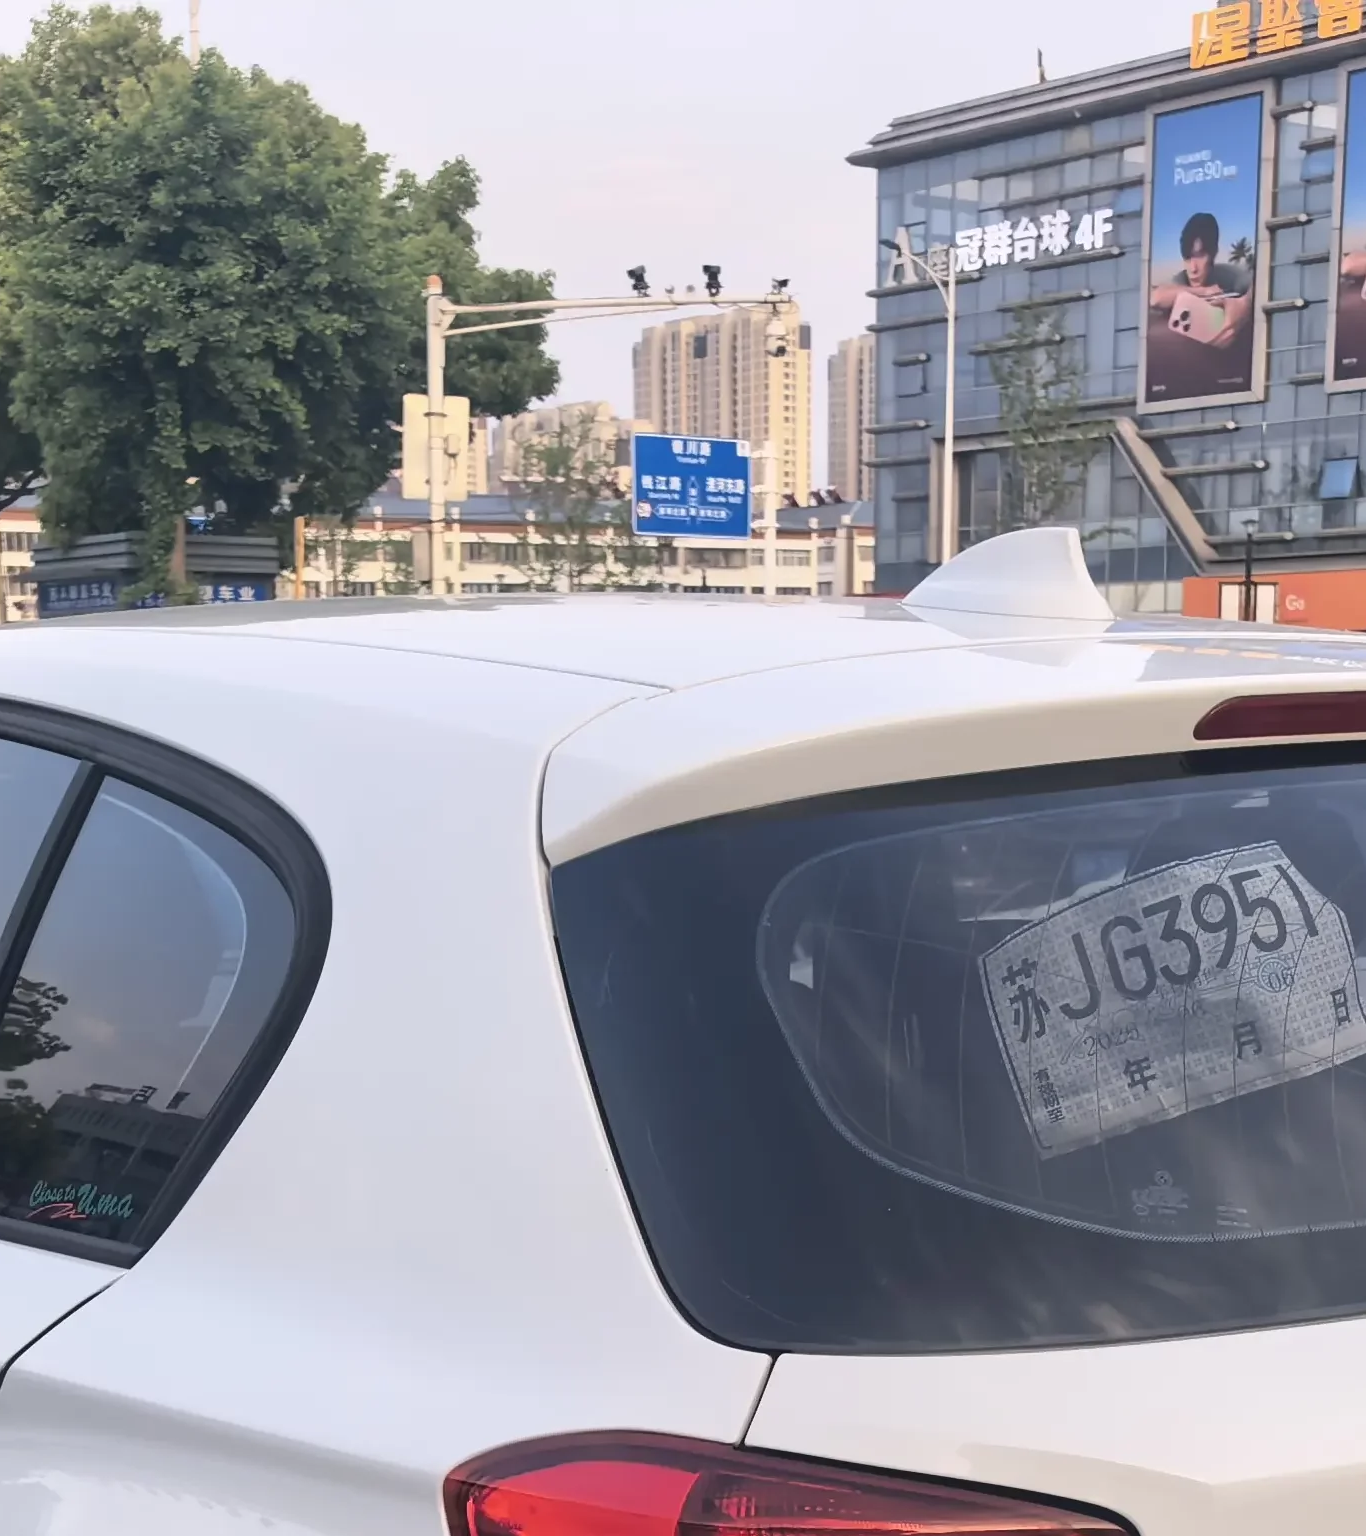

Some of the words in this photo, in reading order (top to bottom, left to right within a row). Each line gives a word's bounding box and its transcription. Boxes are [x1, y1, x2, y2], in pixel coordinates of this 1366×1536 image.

[1175, 150, 1212, 165] HUAWEI
[1123, 1056, 1156, 1091] 年
[1235, 1021, 1262, 1059] 月
